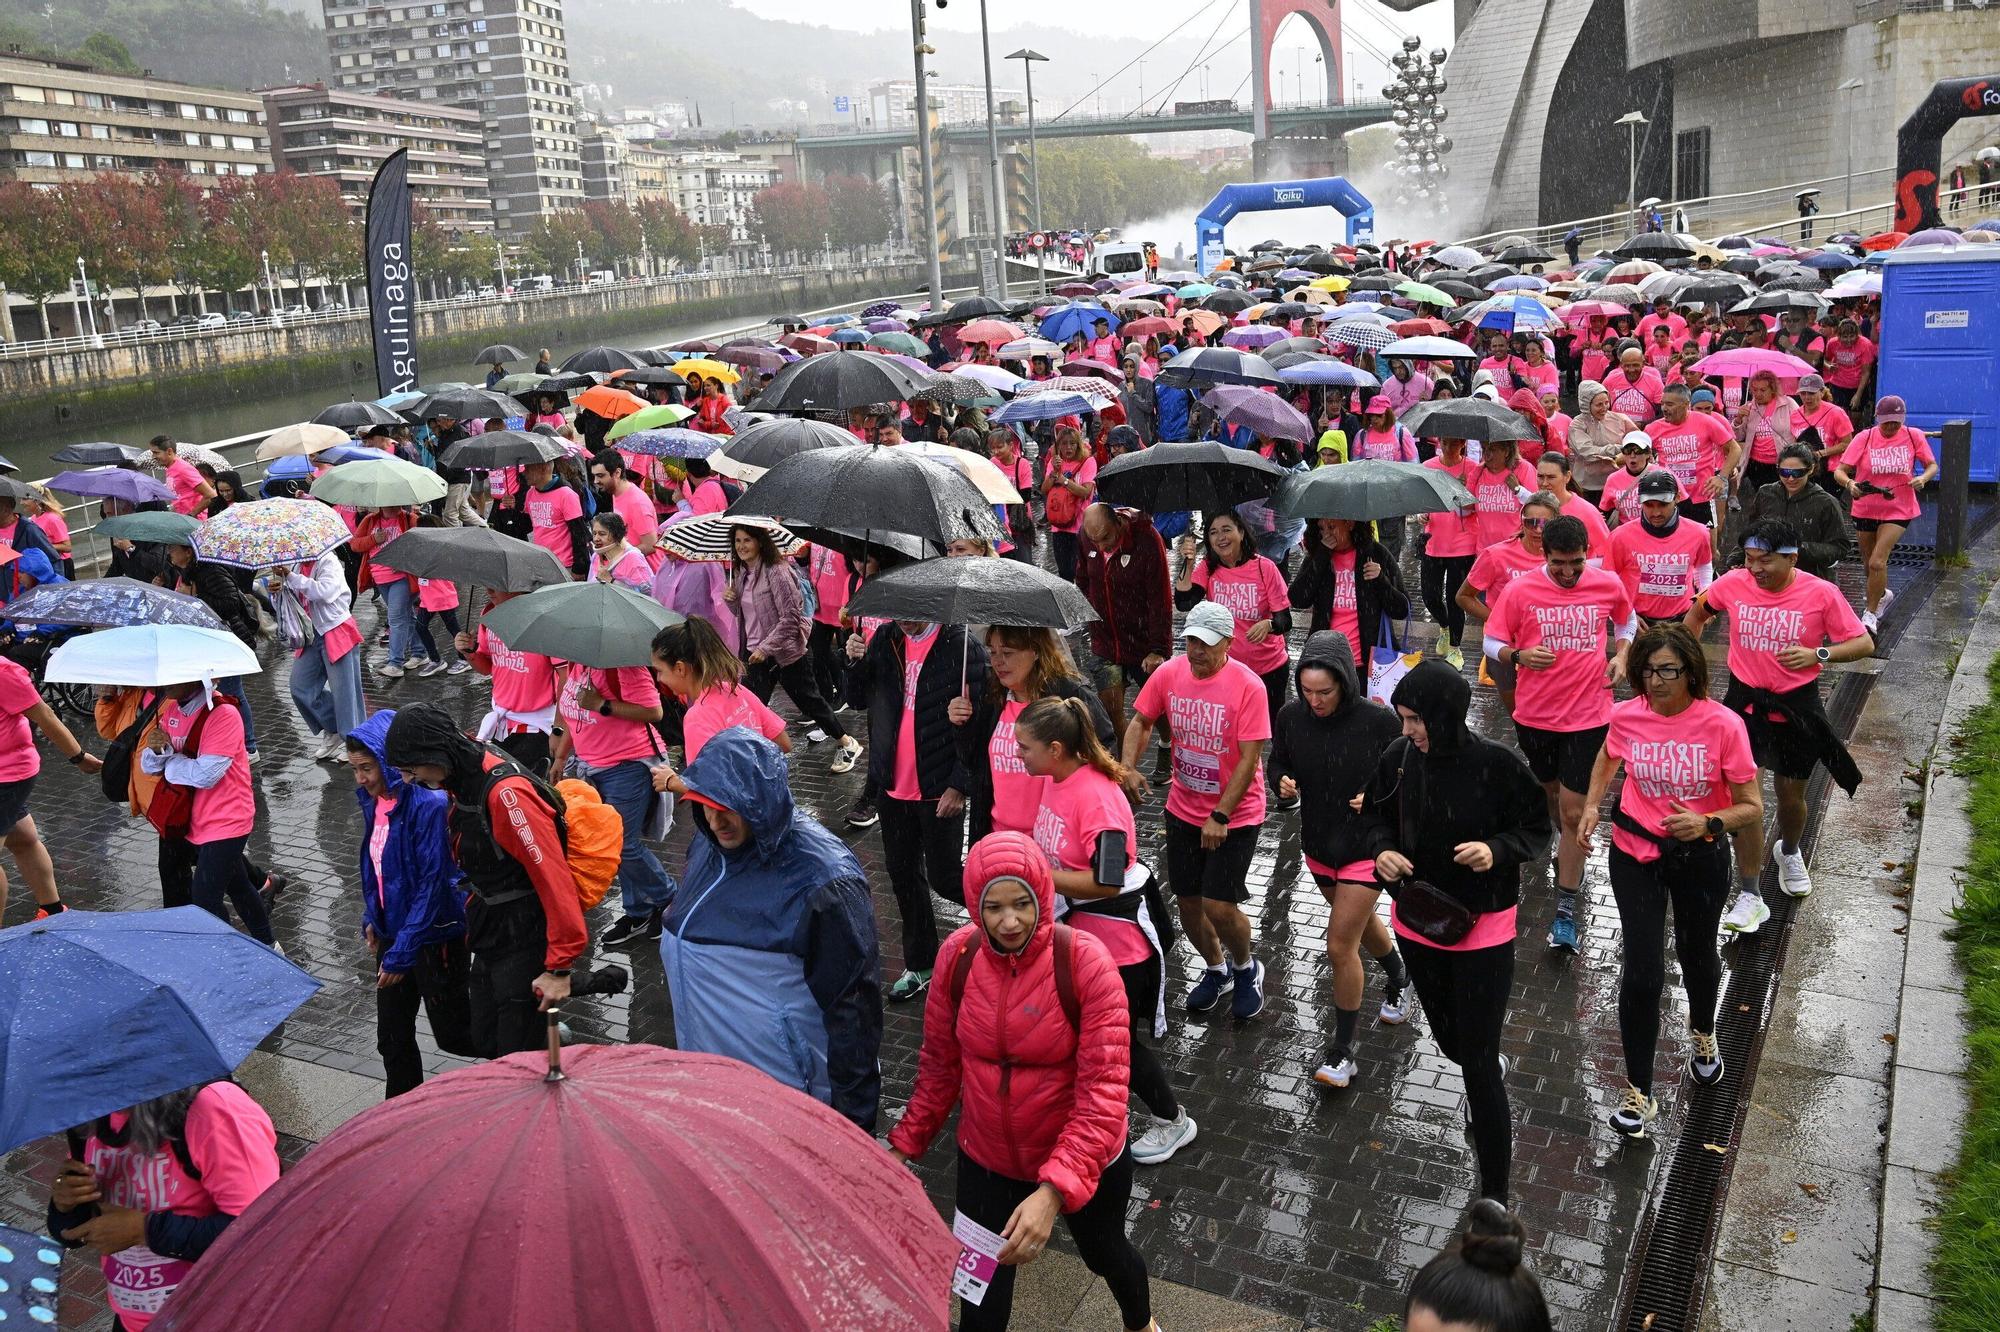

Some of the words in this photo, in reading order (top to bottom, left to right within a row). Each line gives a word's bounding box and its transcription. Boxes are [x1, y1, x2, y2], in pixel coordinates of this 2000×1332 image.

[1277, 190, 1302, 201] Kaiku
[384, 242, 416, 395] Aguinaga
[1649, 574, 1678, 585] 2025
[1180, 761, 1209, 779] 2025
[1639, 779, 1712, 802] AVANZA
[114, 1264, 163, 1288] 2025
